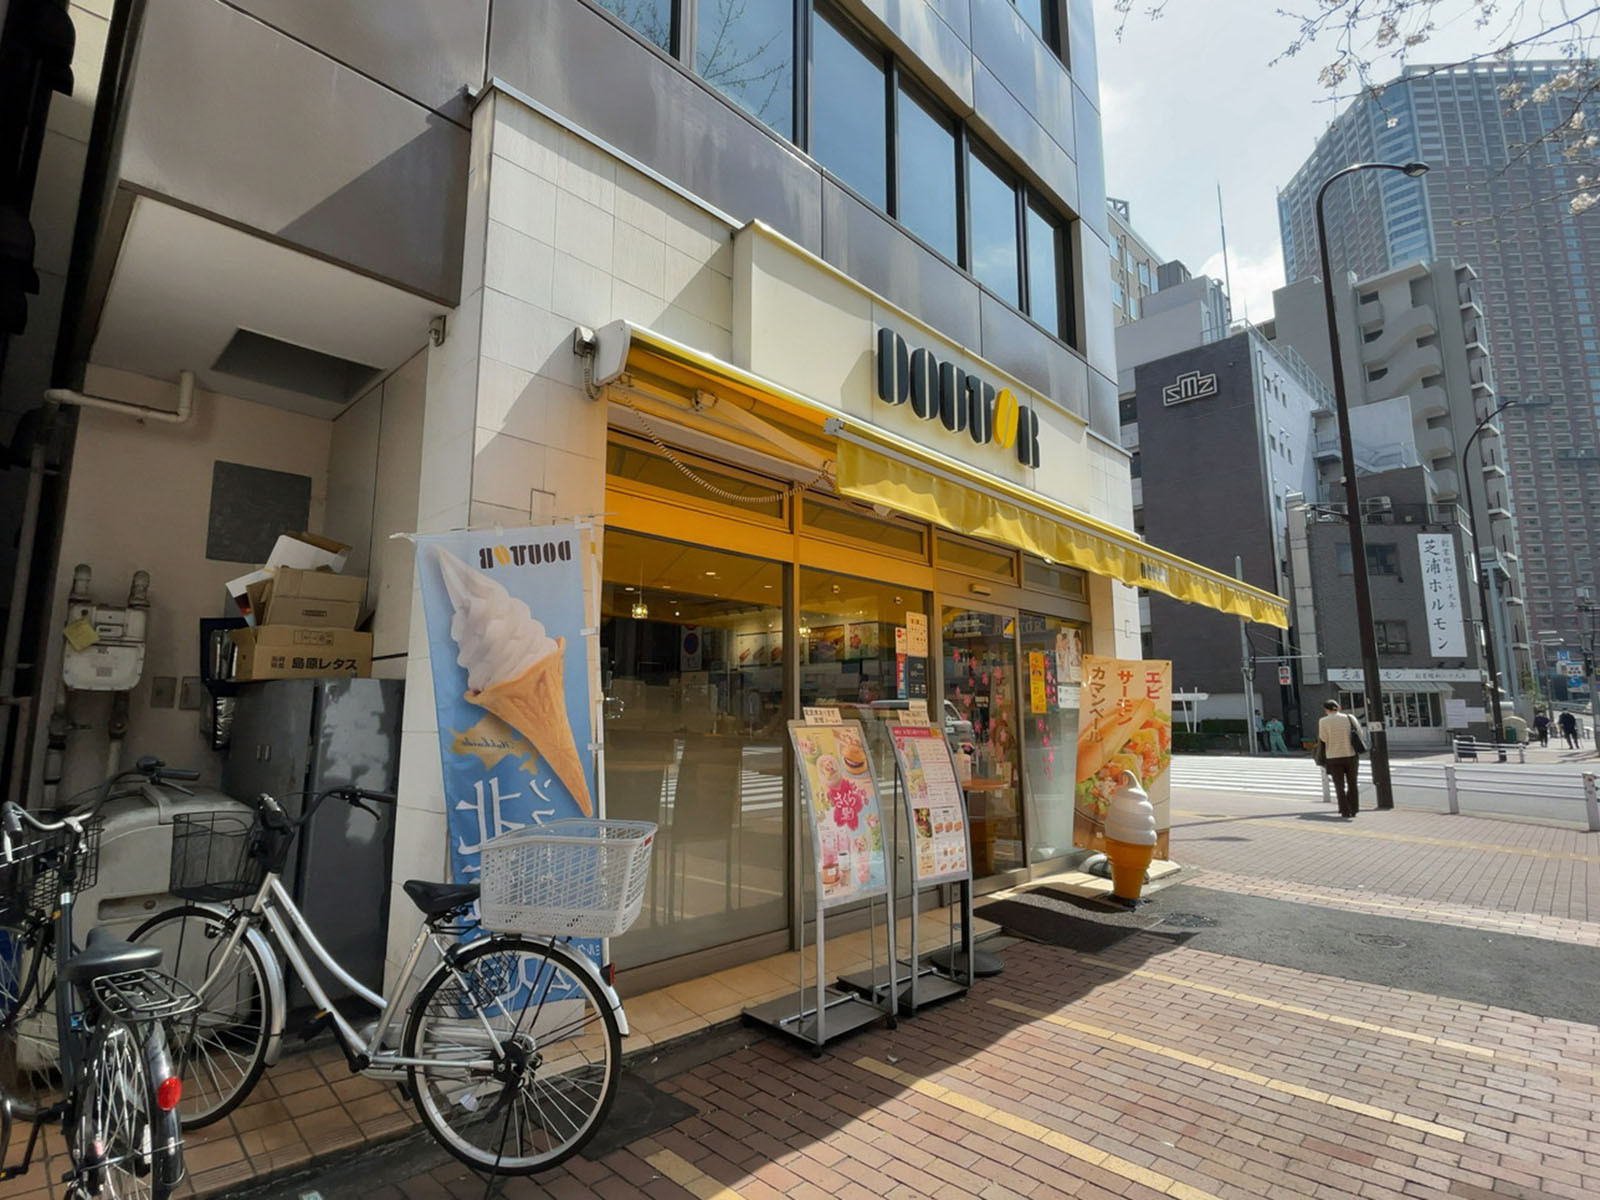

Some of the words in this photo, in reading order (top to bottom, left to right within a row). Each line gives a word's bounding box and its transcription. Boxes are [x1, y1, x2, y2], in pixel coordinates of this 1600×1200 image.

[878, 327, 1040, 469] DOUTOR
[1424, 538, 1449, 651] 芝浦ホルモン
[1087, 666, 1107, 743] カマンベール
[1117, 670, 1134, 726] サーモン
[1145, 671, 1164, 700] エビ
